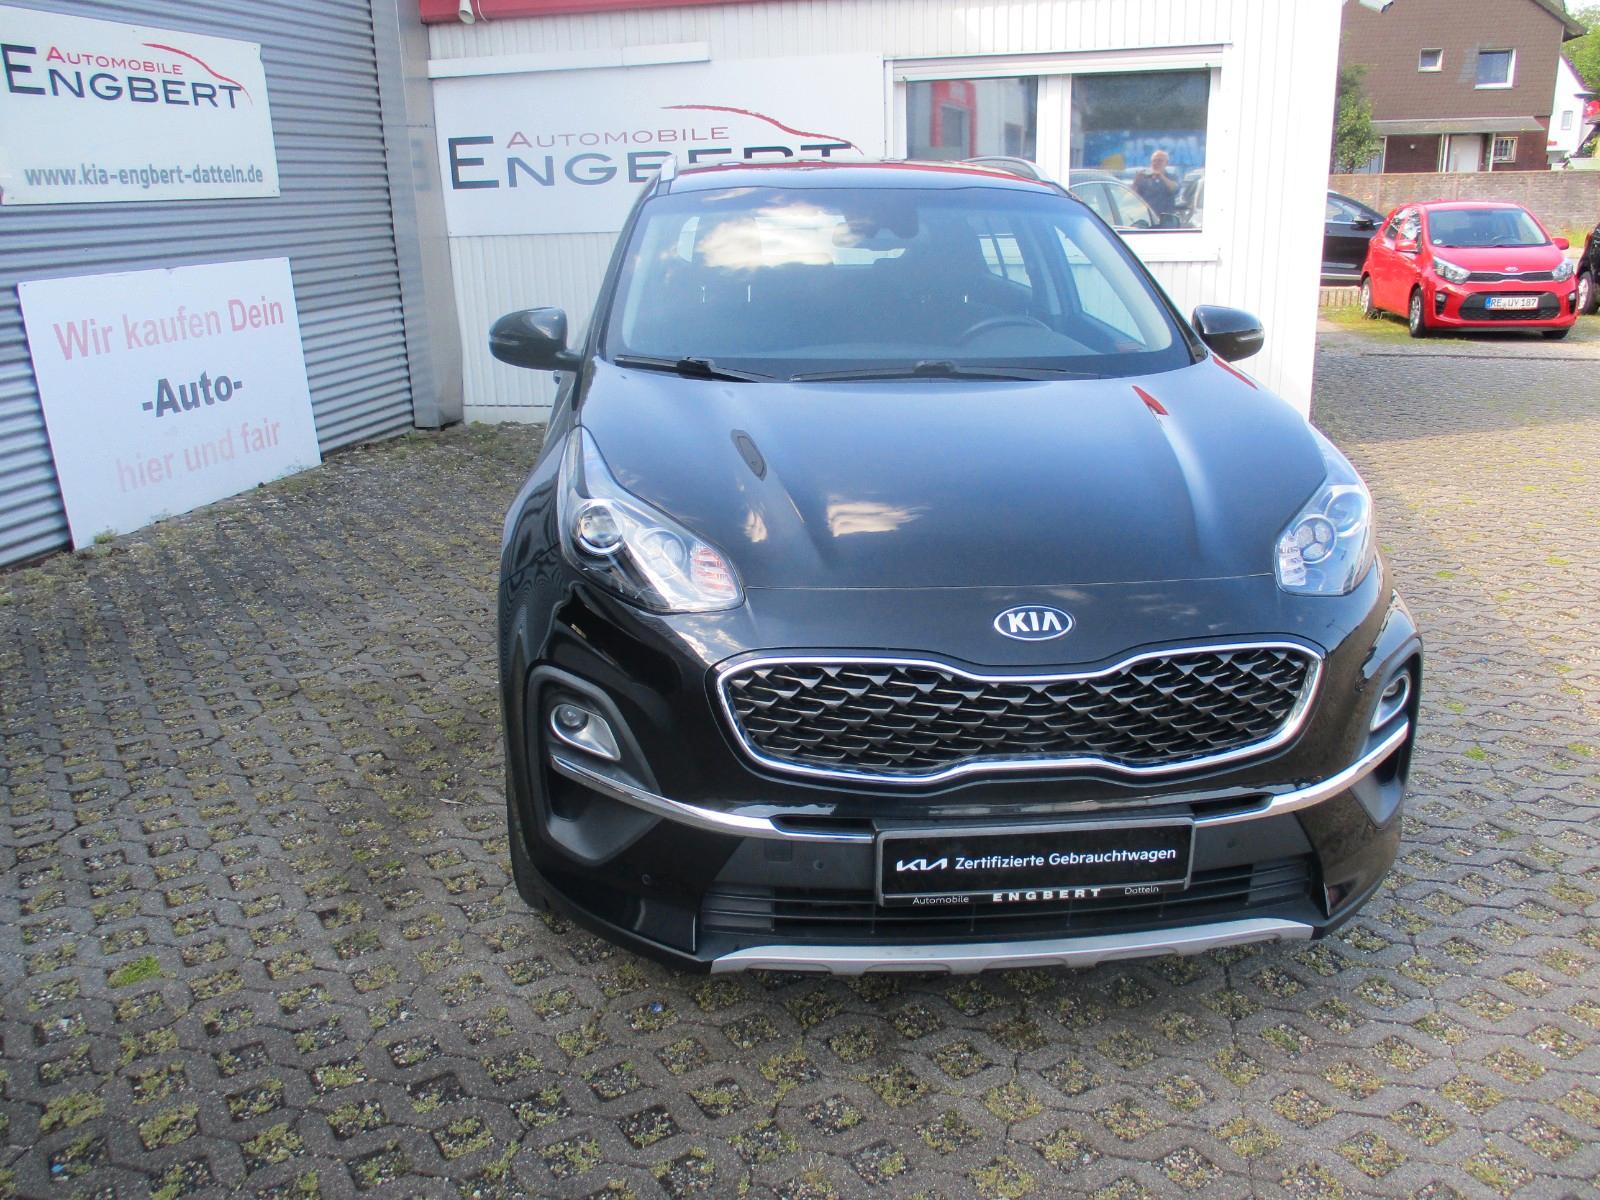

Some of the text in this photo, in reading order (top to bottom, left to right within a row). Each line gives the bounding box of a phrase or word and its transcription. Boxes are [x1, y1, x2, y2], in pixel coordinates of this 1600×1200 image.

[46, 46, 183, 75] AUTOMOBILE
[0, 43, 242, 109] ENGBERT
[506, 126, 729, 149] AUTOMOBILE
[24, 163, 264, 189] www.kia-engbert-datteln.de
[53, 295, 285, 360] Wir kaufen Dein
[142, 371, 243, 418] -Auto-
[116, 418, 281, 493] hier und fair
[1006, 611, 1062, 632] KIA
[955, 854, 1044, 870] Zertifizierte
[1048, 848, 1176, 866] Gebrauchtwagen
[912, 895, 970, 905] Automobile
[992, 888, 1101, 903] ENGBERT
